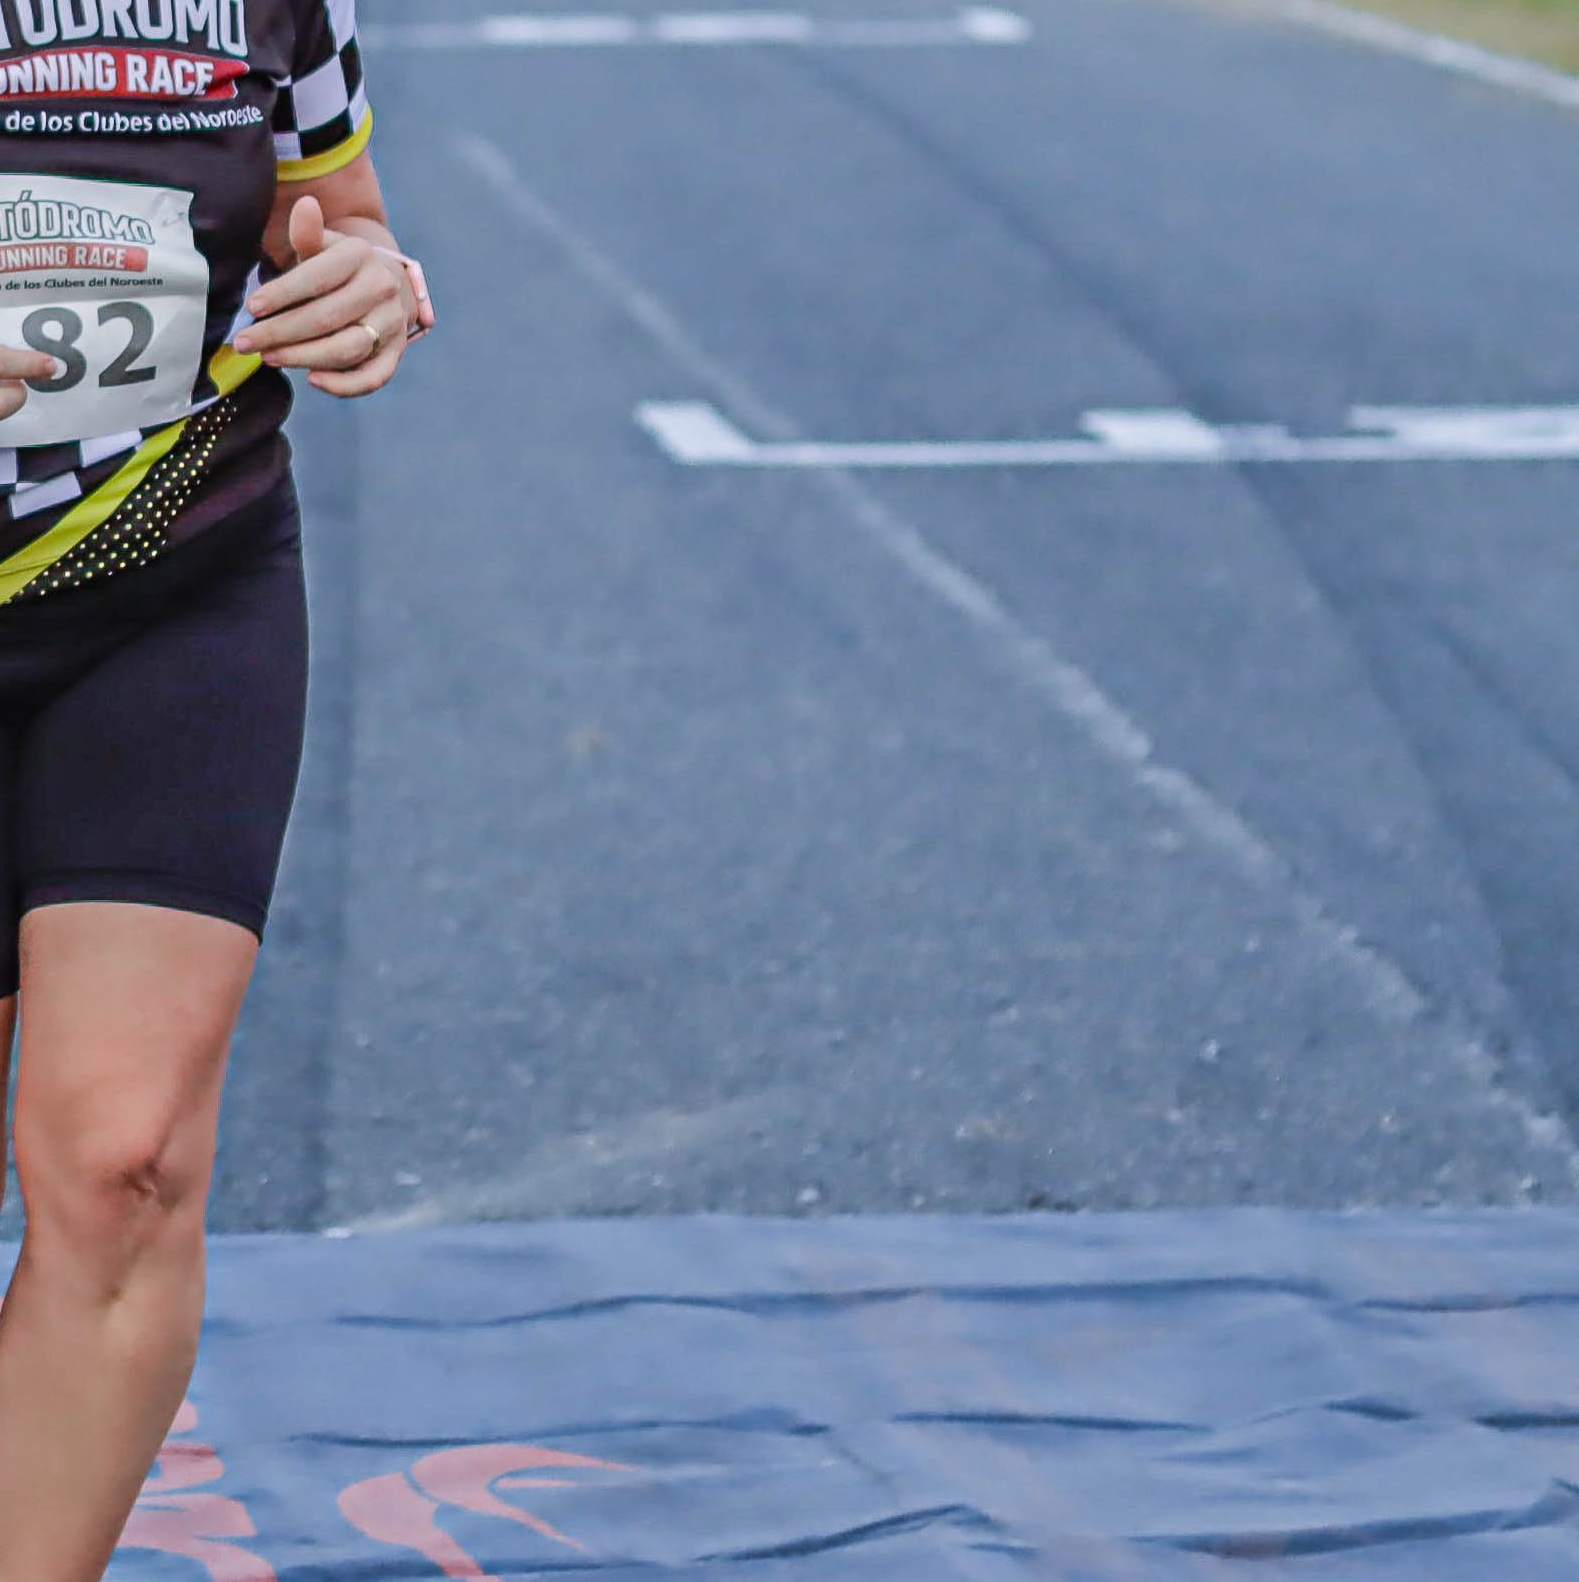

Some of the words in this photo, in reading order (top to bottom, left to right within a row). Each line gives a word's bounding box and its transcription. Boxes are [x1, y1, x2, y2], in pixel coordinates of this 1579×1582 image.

[125, 52, 215, 96] RACE
[5, 110, 33, 130] de
[41, 110, 73, 131] los
[79, 111, 153, 131] Clubes
[157, 111, 190, 131] del
[189, 104, 264, 129] Noroeste
[74, 246, 126, 269] RACE
[5, 280, 21, 291] de
[24, 279, 41, 290] los
[44, 277, 86, 289] Clubes
[89, 276, 108, 287] del
[110, 275, 164, 287] Noroeste
